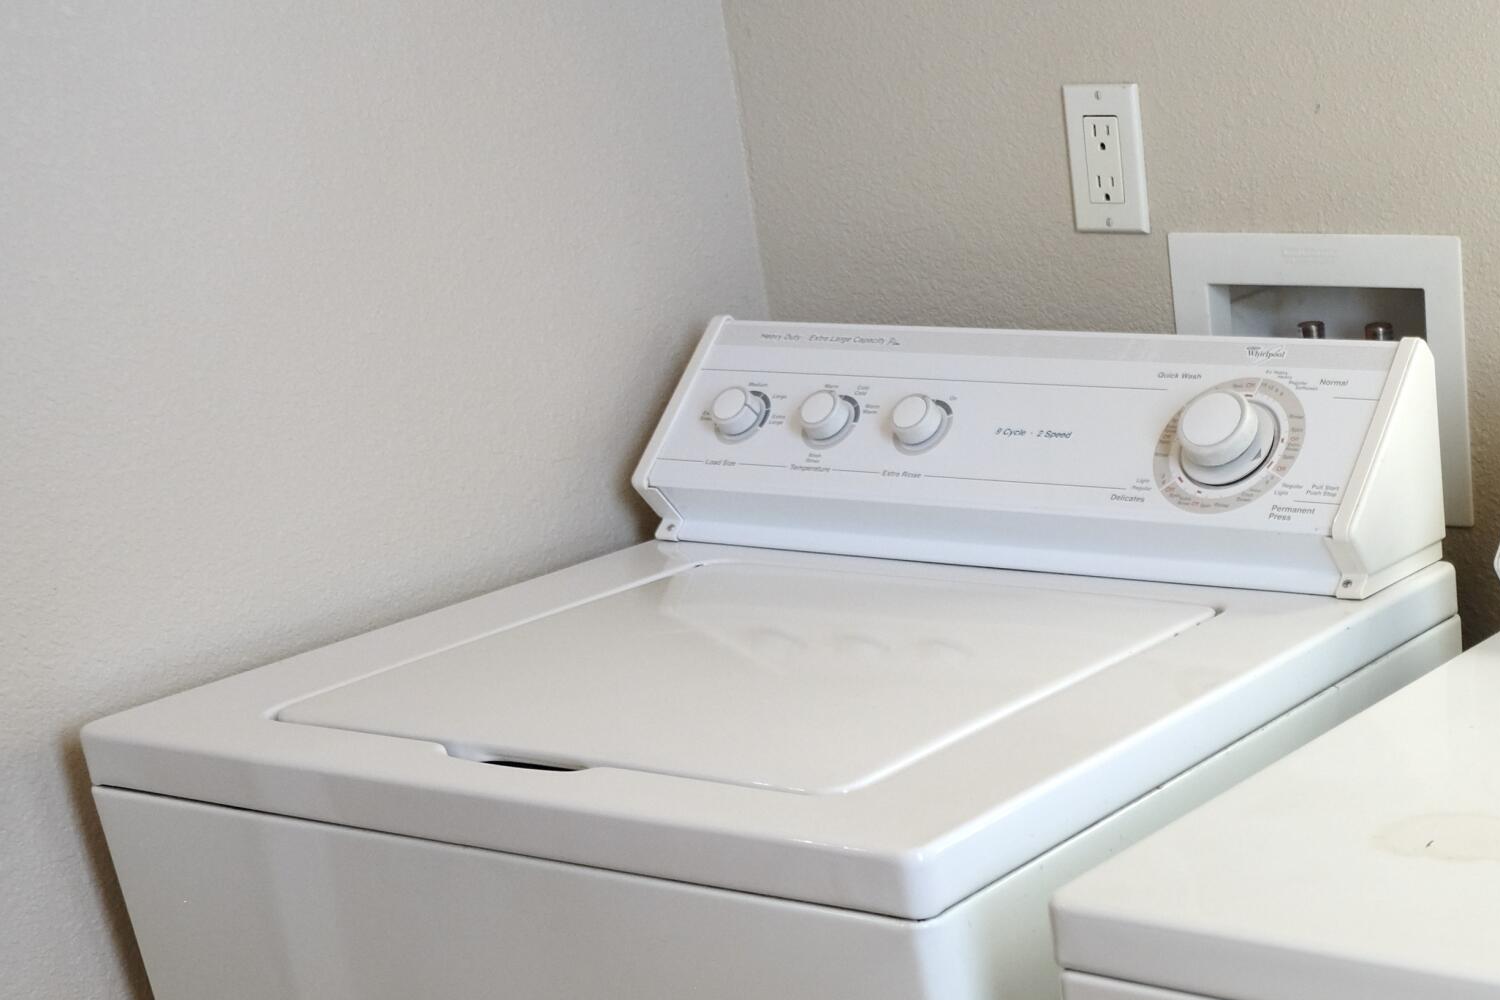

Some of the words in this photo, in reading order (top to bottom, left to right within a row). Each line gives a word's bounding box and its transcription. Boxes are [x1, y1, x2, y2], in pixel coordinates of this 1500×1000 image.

[808, 334, 828, 342] Extra
[830, 335, 852, 344] Large
[1246, 346, 1286, 360] Whirlpool
[1158, 371, 1178, 379] Quick
[1320, 378, 1349, 387] Normal
[1004, 428, 1026, 438] Cycle
[1045, 430, 1072, 440] Speed
[705, 459, 721, 467] Load
[723, 459, 737, 467] Size
[790, 463, 831, 474] Temperature
[882, 469, 901, 477] Extra
[902, 471, 922, 479] Rinse
[1110, 493, 1145, 503] Delicates
[1271, 504, 1316, 516] Permanent
[1268, 512, 1292, 521] Press
